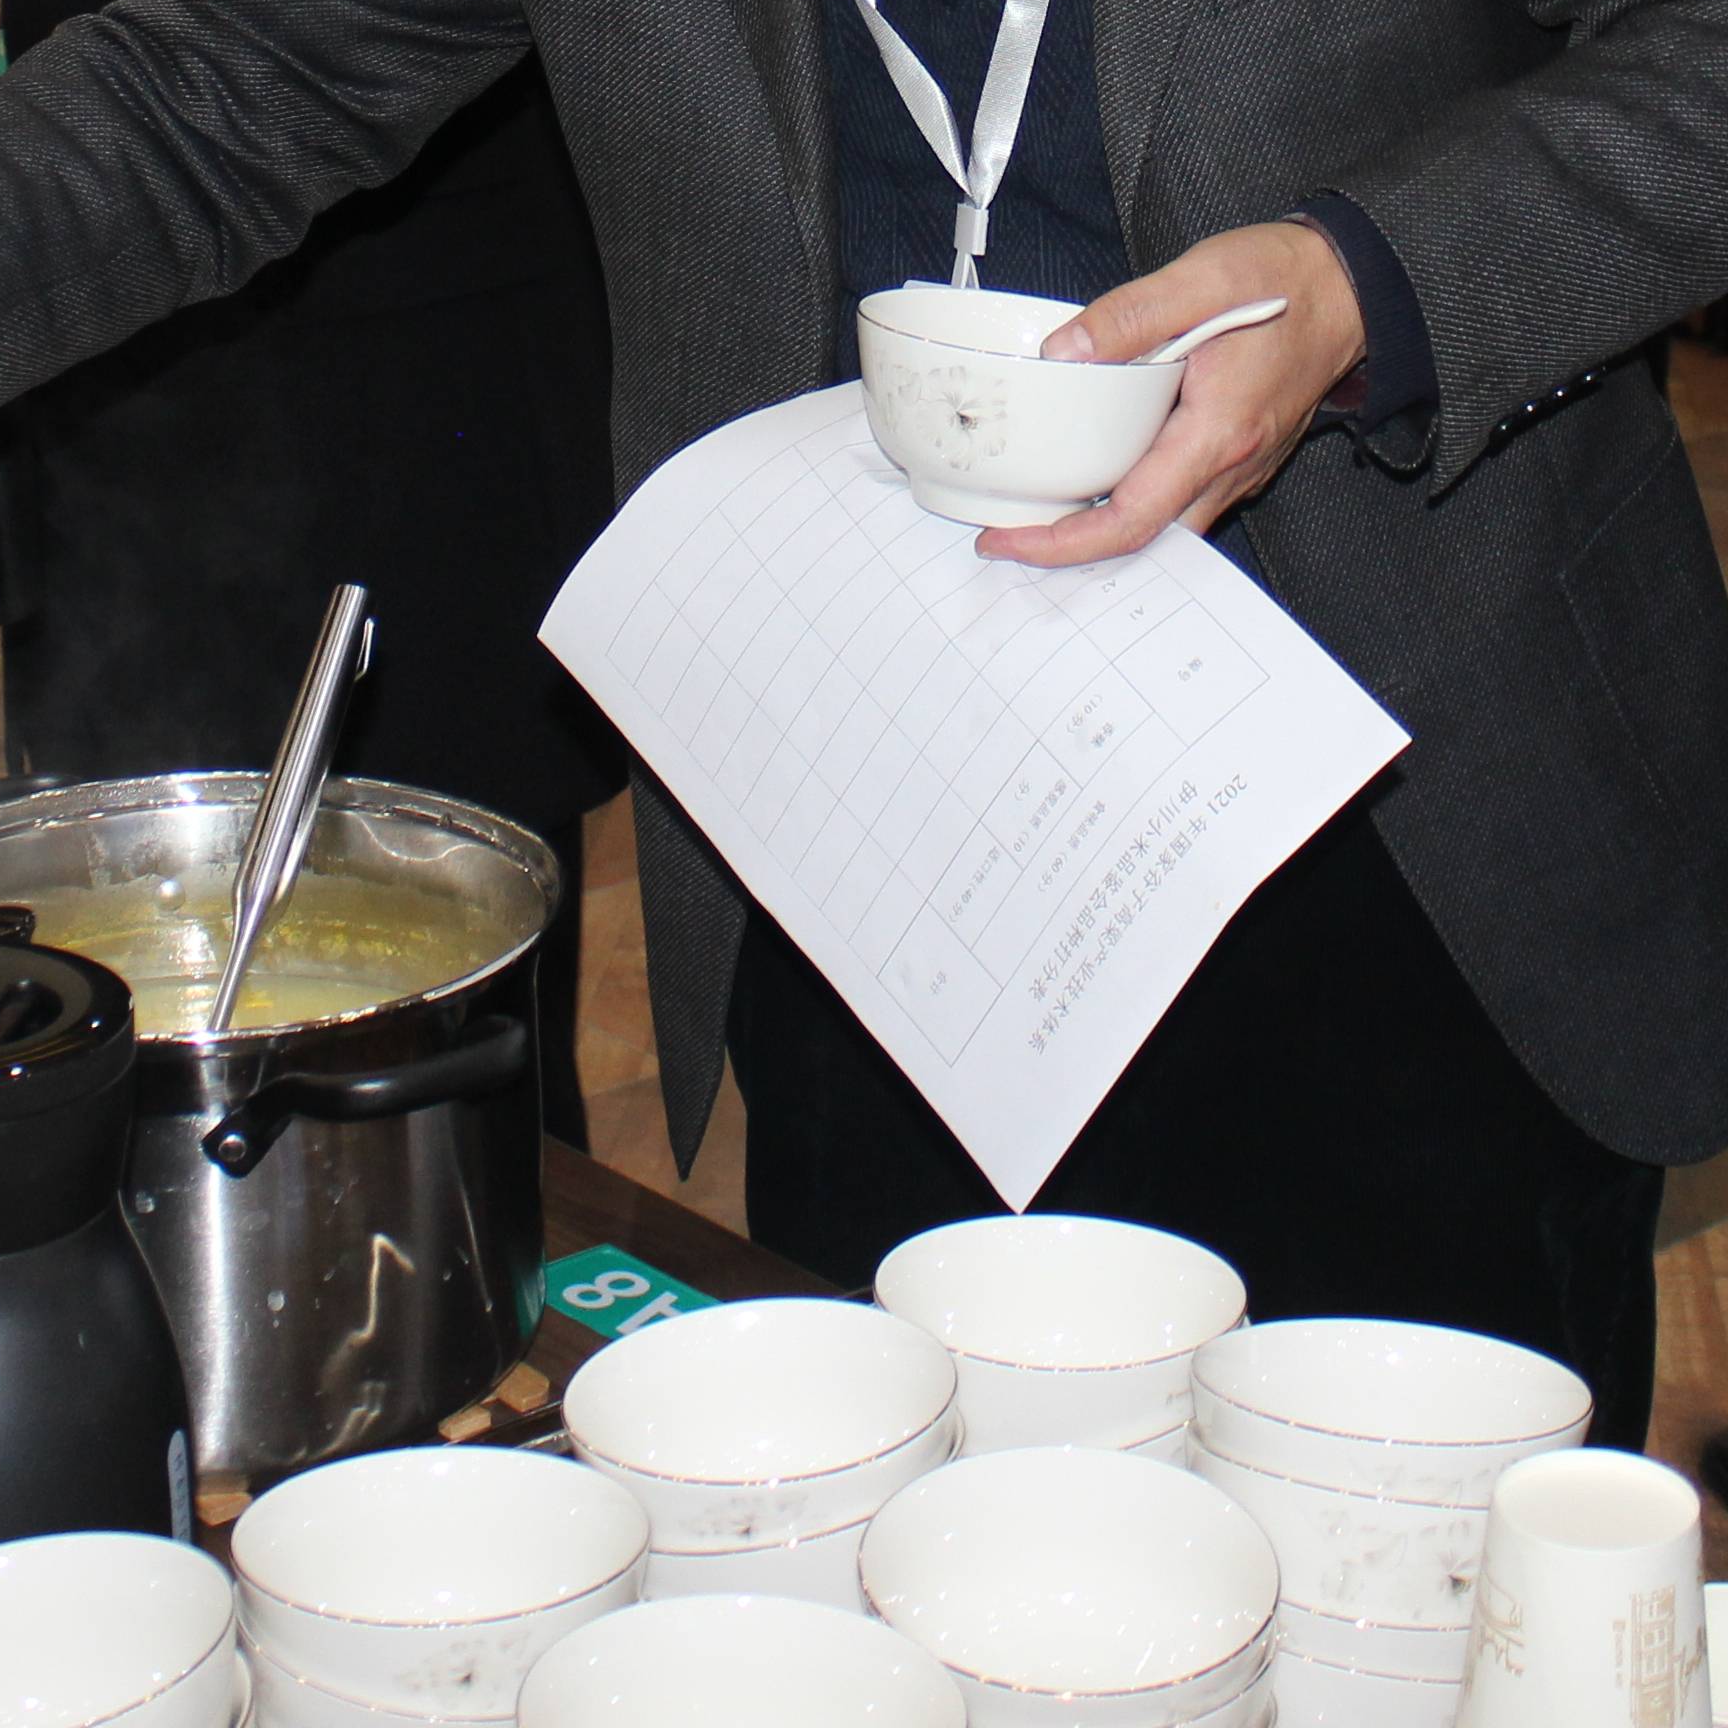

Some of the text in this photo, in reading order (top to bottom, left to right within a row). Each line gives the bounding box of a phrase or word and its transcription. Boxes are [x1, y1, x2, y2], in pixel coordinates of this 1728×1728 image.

[1101, 578, 1117, 593] A2
[1129, 605, 1145, 621] A1
[1028, 779, 1198, 1003] 伊川小米品鉴会品种打分表
